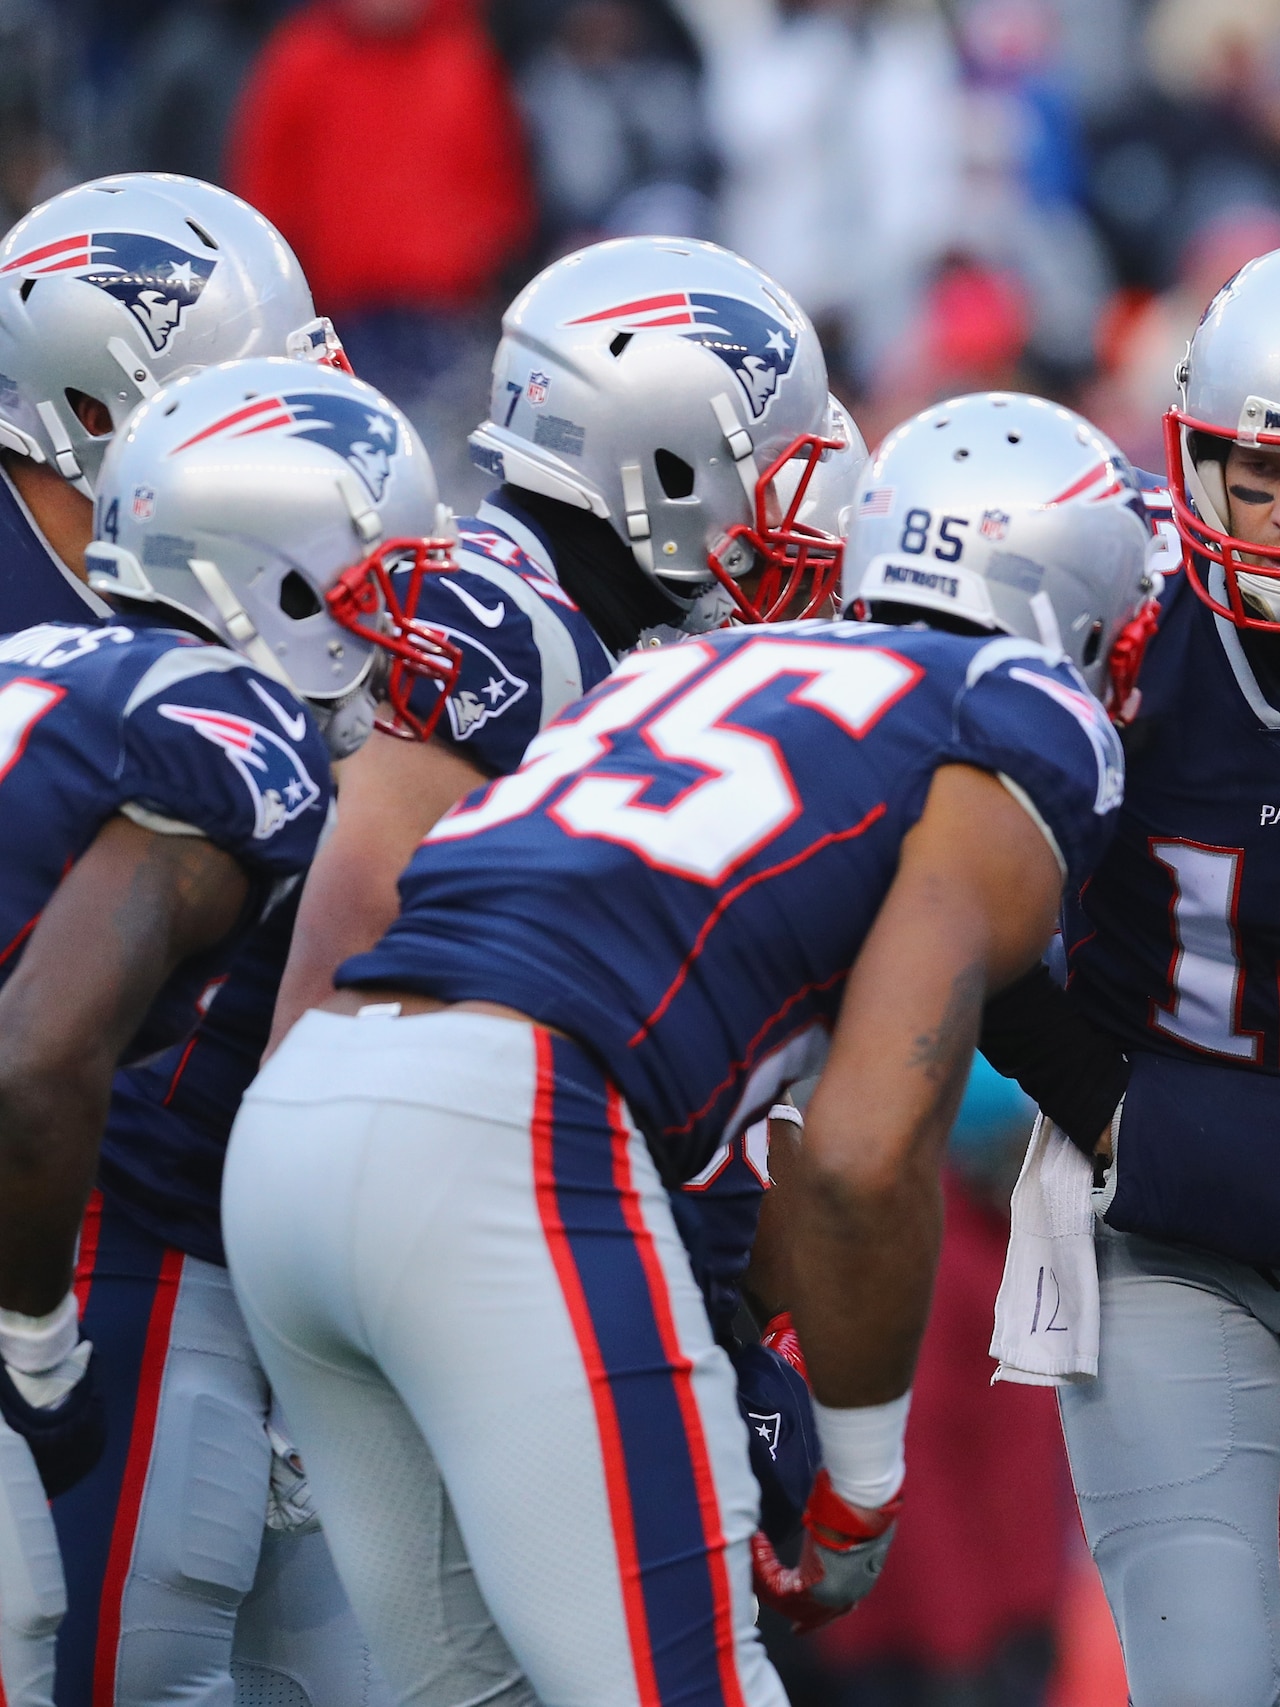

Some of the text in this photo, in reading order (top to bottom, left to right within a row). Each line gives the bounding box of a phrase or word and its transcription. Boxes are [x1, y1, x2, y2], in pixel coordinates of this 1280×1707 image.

[900, 508, 970, 563] 85
[884, 564, 960, 599] PATRIOTS
[1030, 1265, 1068, 1336] 12
